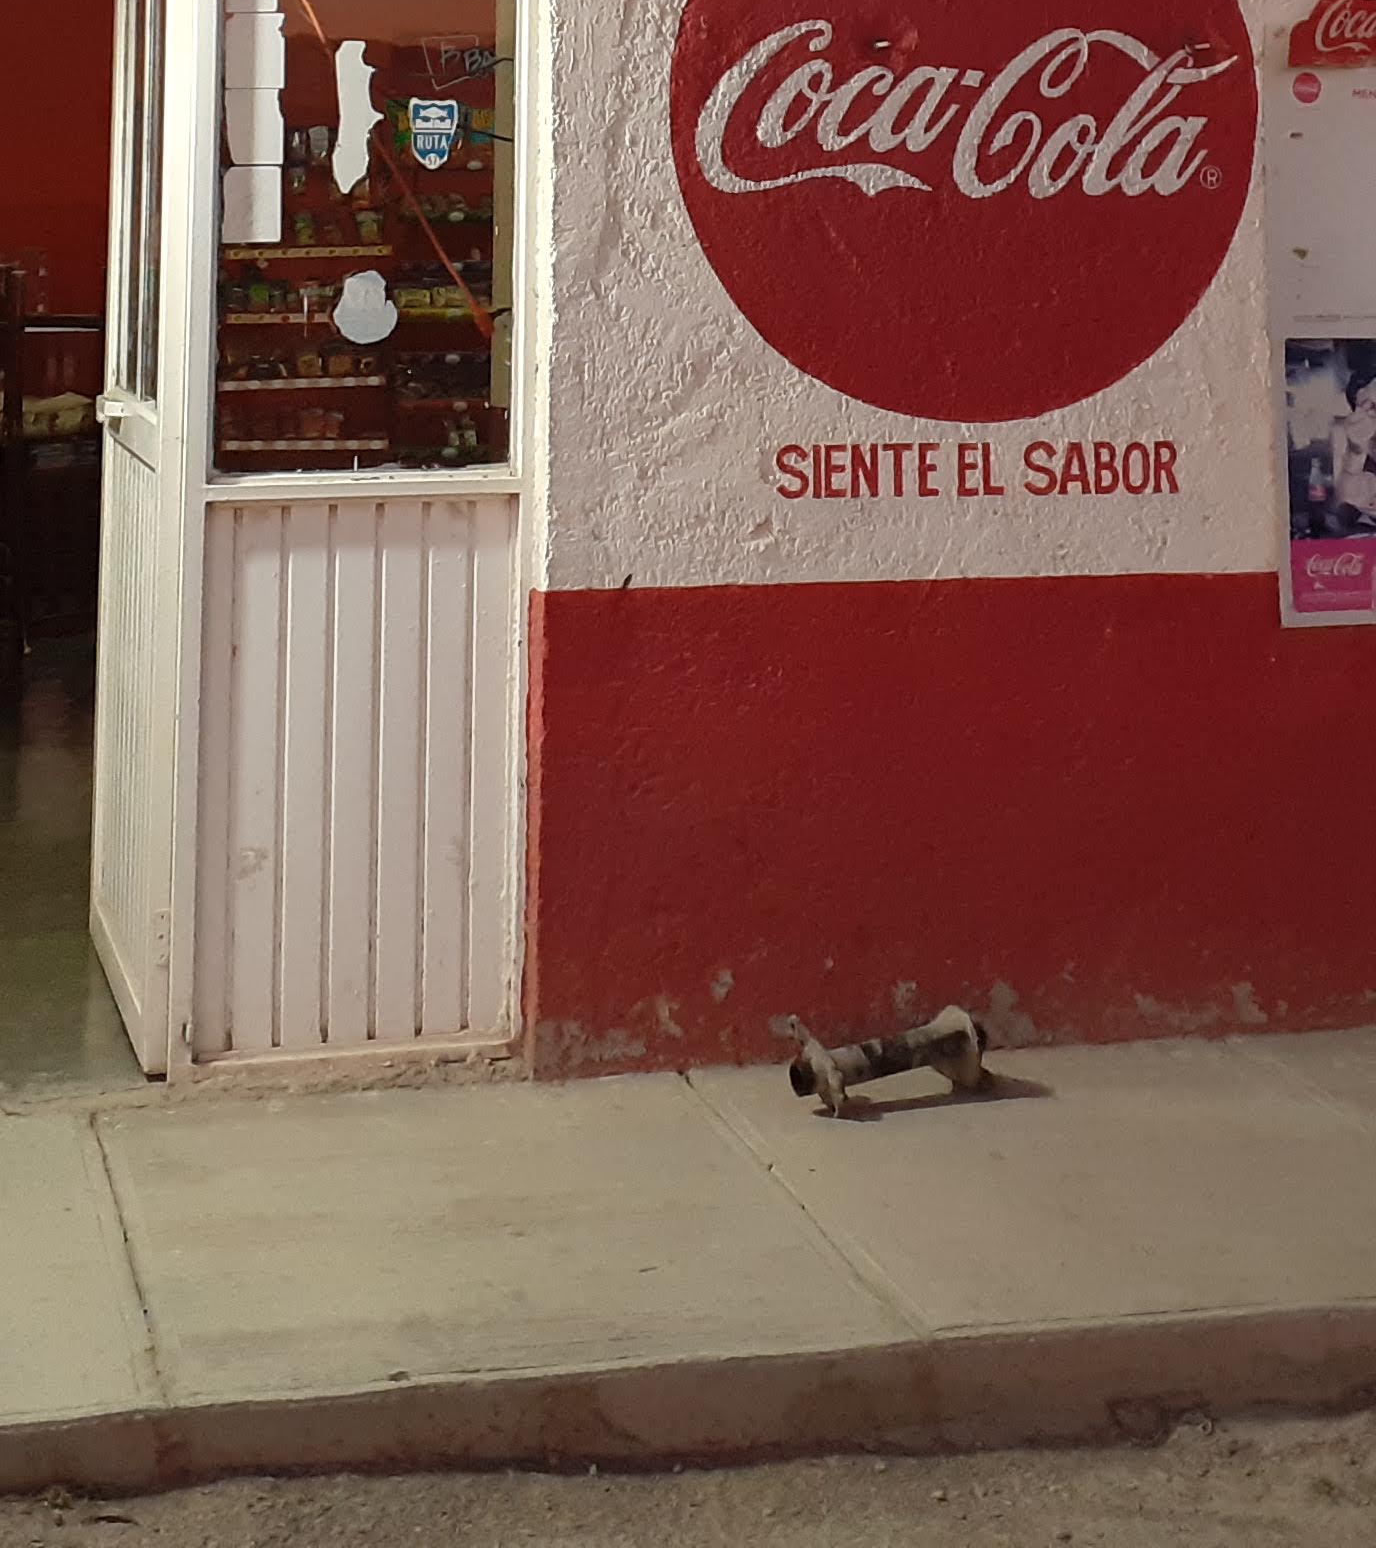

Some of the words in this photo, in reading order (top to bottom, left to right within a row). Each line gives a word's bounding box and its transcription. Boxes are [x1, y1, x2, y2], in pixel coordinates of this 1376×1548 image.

[694, 19, 1238, 199] Coca-Cola
[416, 134, 448, 150] RUTA
[775, 443, 940, 499] SIENTE
[957, 442, 1005, 498] EL
[1024, 440, 1180, 497] SABOR
